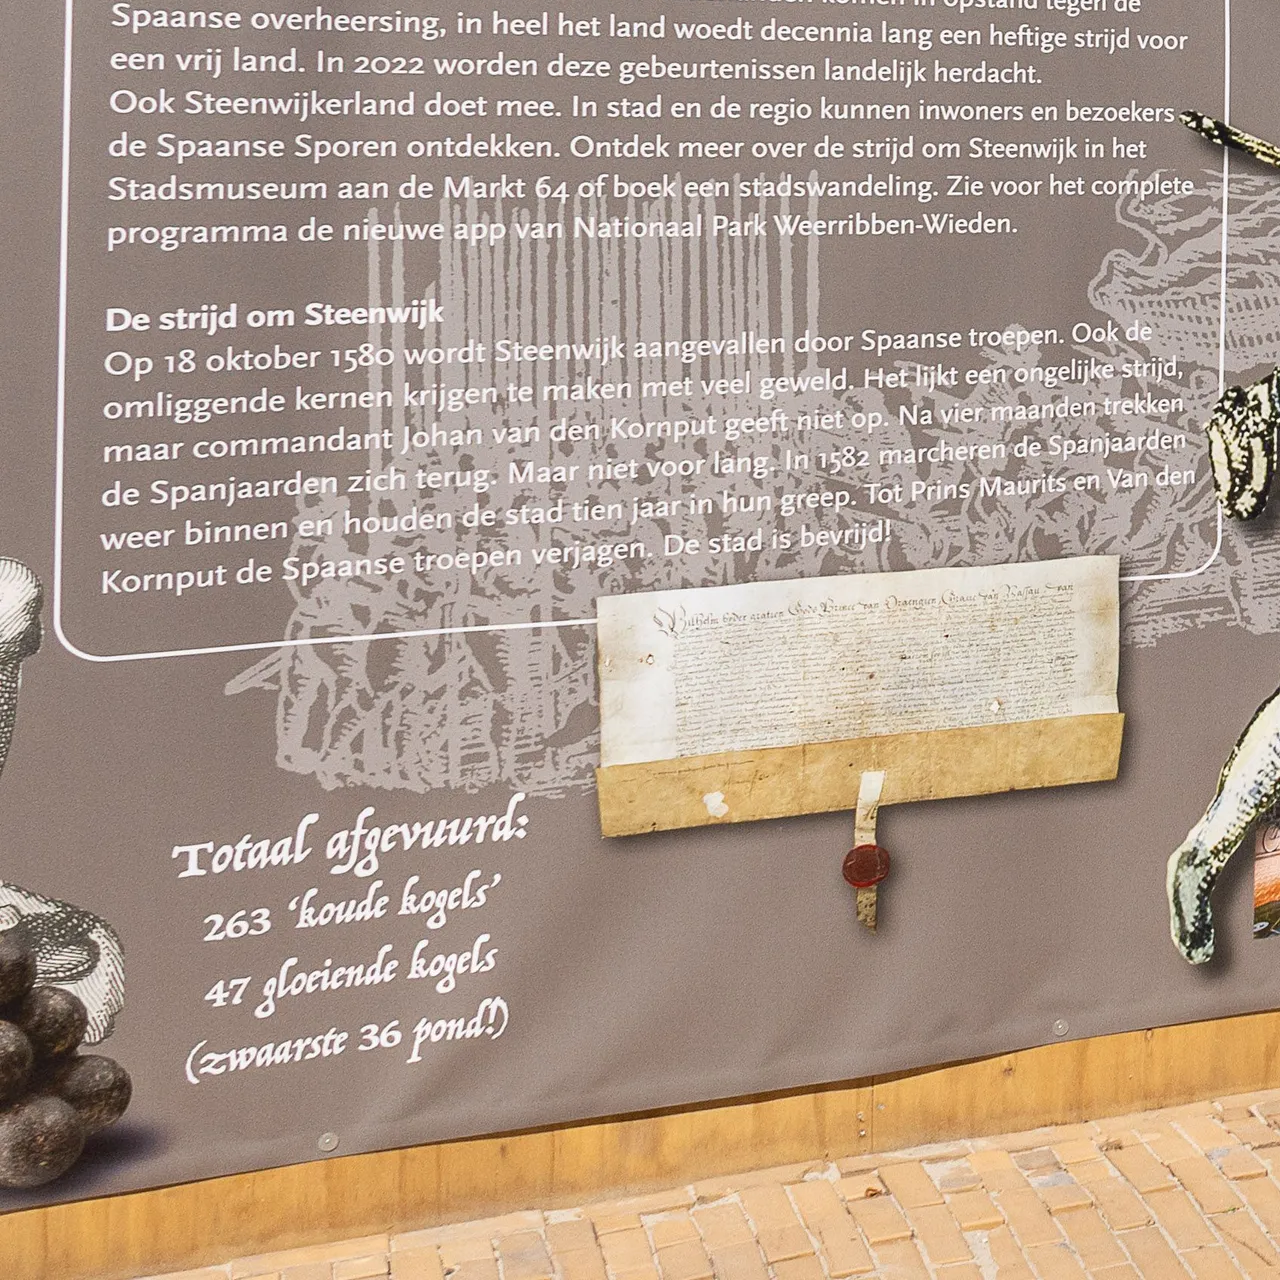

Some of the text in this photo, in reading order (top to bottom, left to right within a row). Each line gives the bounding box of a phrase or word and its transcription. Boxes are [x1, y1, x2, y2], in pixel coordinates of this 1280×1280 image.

[110, 88, 1175, 126] Ook Steenwijkerland doet mee. In stad en de regio kunnen inwoners en bezoekers
[108, 211, 1018, 252] programma de nieuwe app van Nationaal Park Weerribben-Wieden.
[106, 298, 445, 336] De strijd om Steenwijk
[102, 518, 891, 596] Kornput de Spaanse troepen verjagen. De stad is bevrijd!
[172, 793, 531, 879] Totaal afgevuurd:
[202, 870, 502, 942] 263 ‘koude kogels’
[204, 933, 498, 1019] 47 gloeiende kogels
[186, 996, 510, 1084] (zwaarste 36 pond!)
